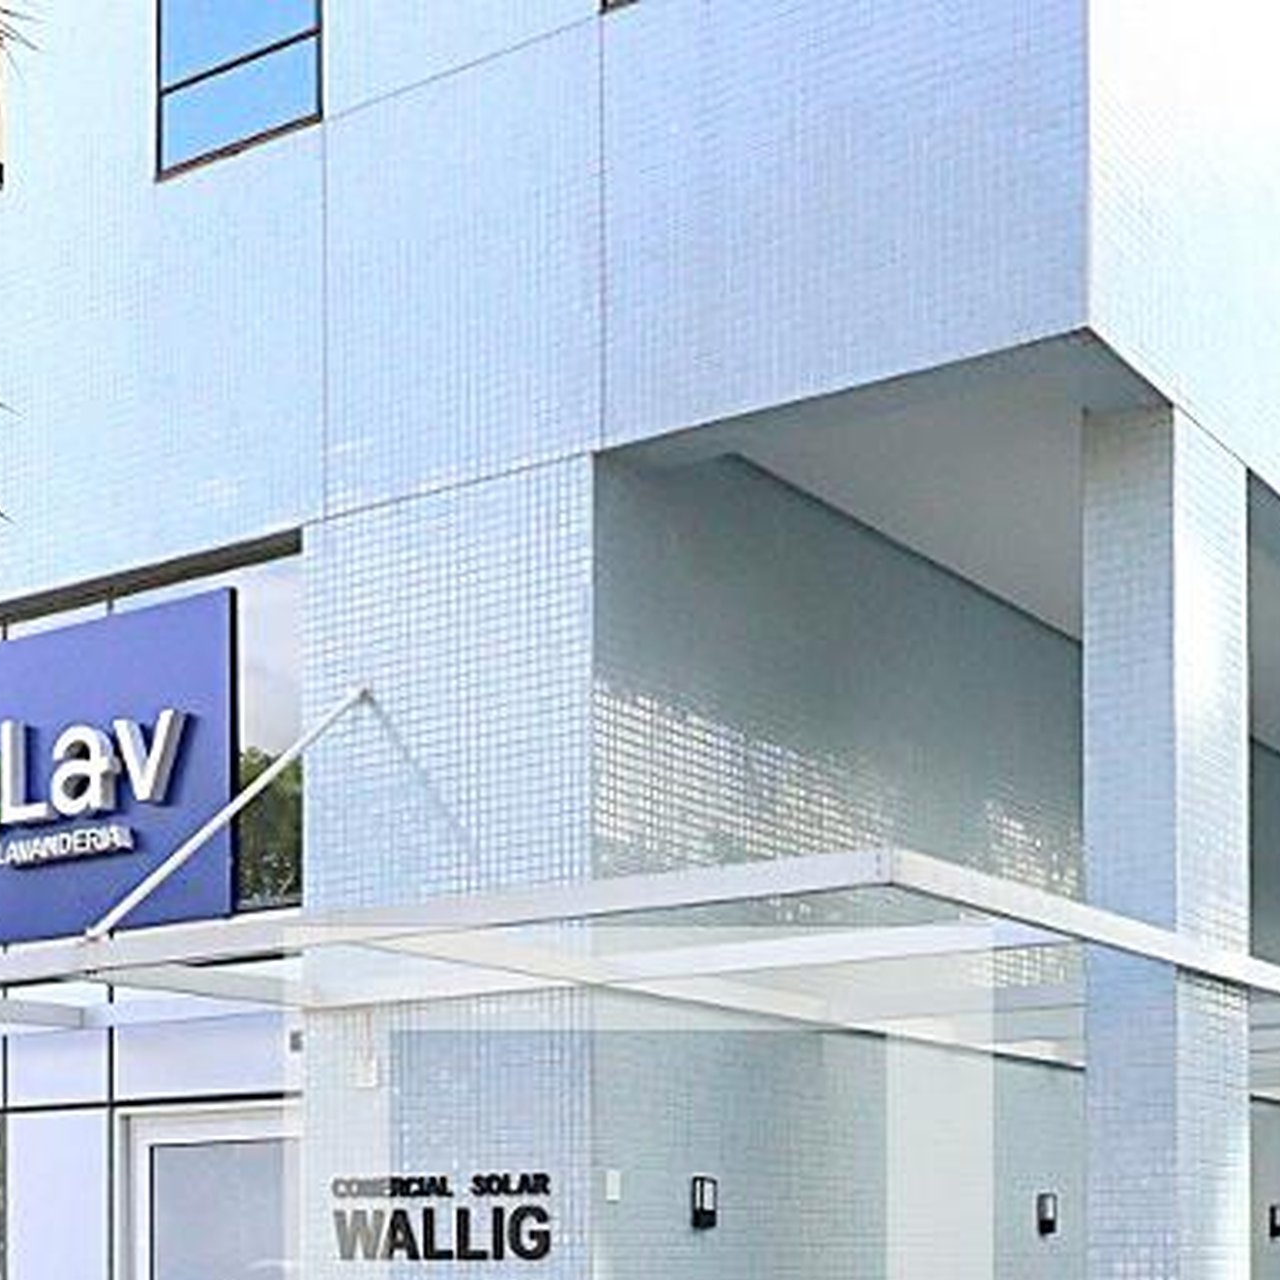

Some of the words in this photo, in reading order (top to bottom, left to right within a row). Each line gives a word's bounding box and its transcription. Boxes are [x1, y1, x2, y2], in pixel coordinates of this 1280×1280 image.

[332, 1176, 454, 1198] COMERCIAL
[471, 1173, 551, 1197] SOLAR
[332, 1205, 552, 1261] WALLIG
